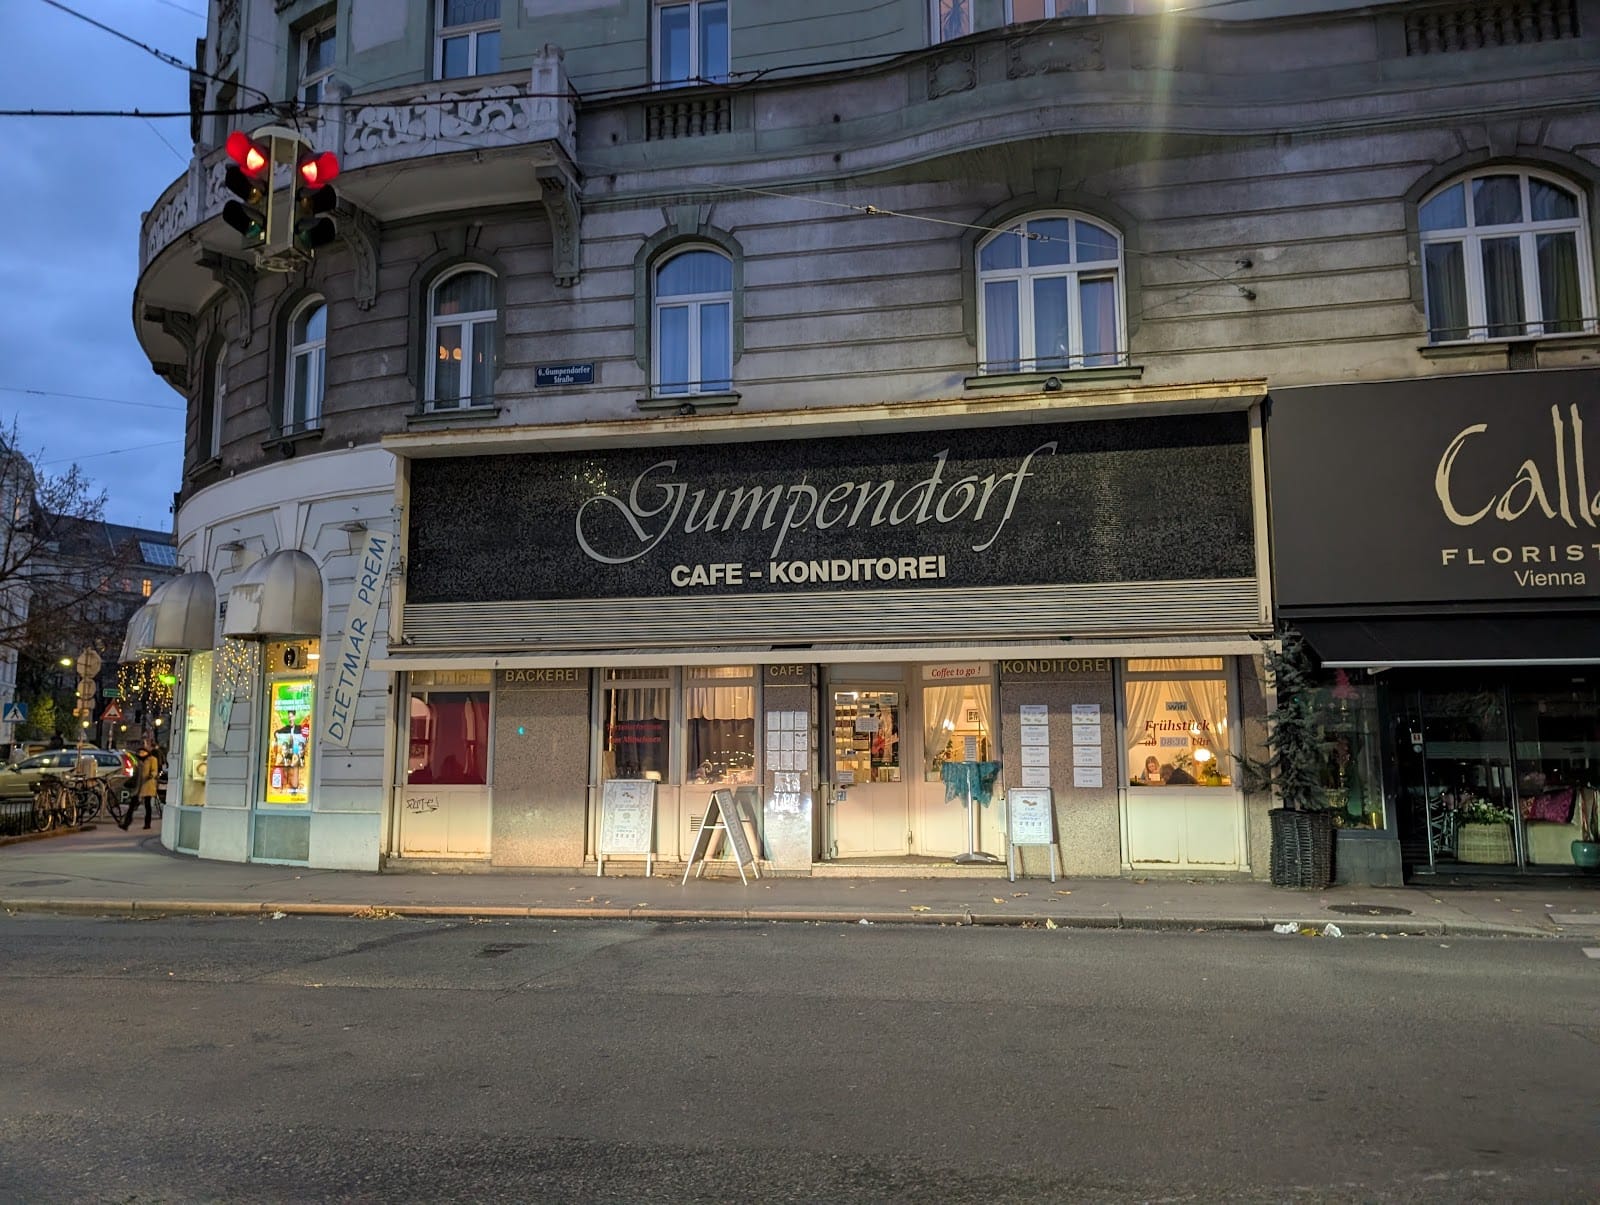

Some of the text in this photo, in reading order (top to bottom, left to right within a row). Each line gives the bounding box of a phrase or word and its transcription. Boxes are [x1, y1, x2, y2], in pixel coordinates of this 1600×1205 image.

[545, 366, 591, 376] Gumpendorfer
[553, 375, 574, 384] Straße
[1435, 403, 1600, 528] Call
[575, 441, 1058, 564] Gumpendorf
[671, 561, 743, 588] CAFE
[768, 555, 946, 584] KONDITOREI
[1514, 569, 1586, 587] Vienna
[328, 537, 388, 740] DIETMAR PREM
[770, 665, 804, 677] CAFE
[931, 667, 955, 679] Coffee
[956, 668, 964, 676] to
[966, 669, 976, 677] go
[1002, 659, 1111, 674] KONDITOREI
[1145, 720, 1210, 732] Frühstück
[1192, 737, 1211, 746] Uhr
